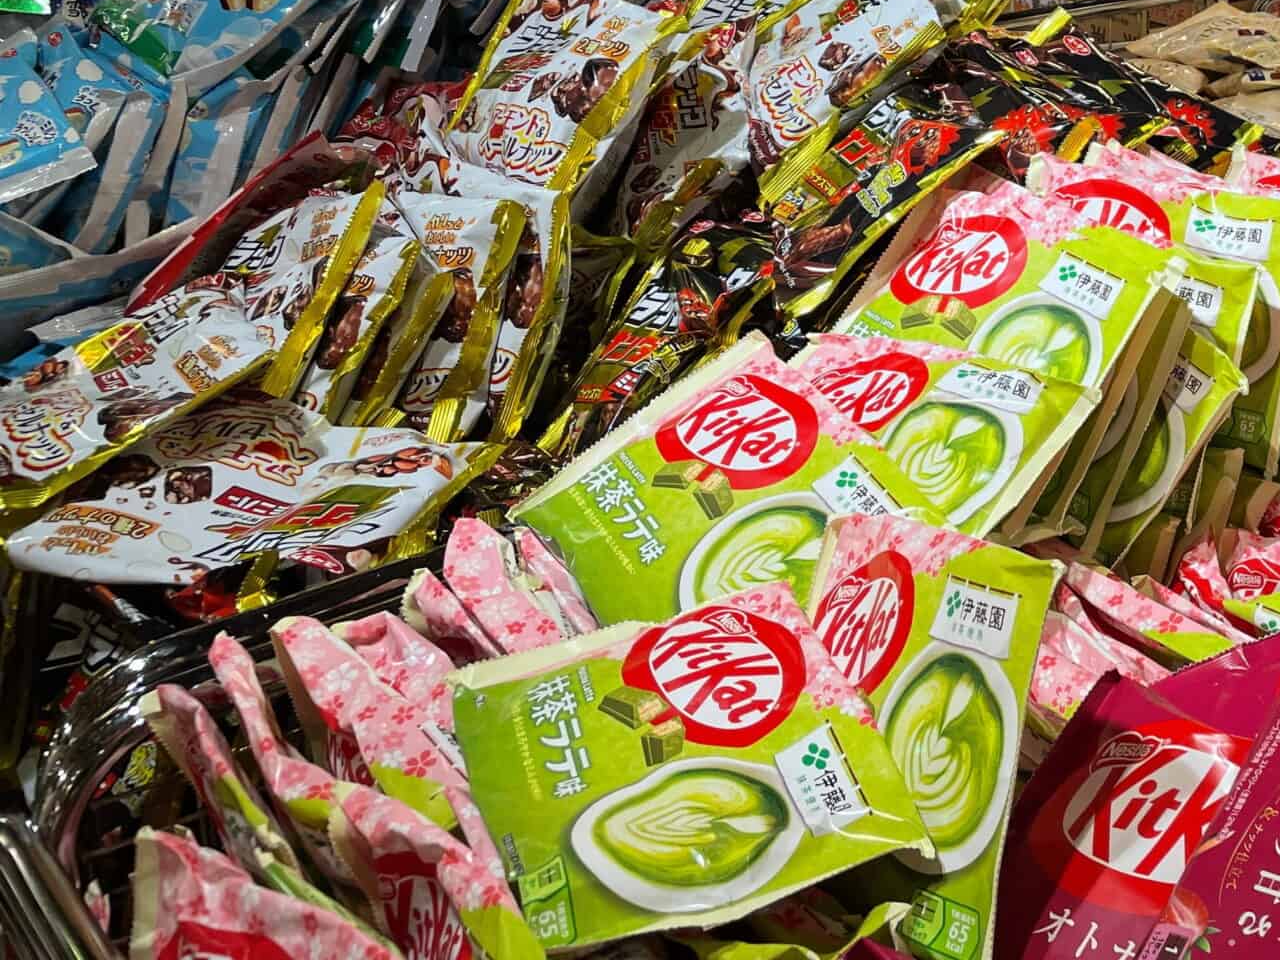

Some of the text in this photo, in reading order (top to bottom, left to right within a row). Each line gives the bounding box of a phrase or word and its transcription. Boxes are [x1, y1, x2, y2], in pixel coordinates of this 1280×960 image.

[905, 231, 1008, 293] KitKat
[1216, 224, 1263, 245] 伊藤園
[1076, 272, 1114, 303] 伊藤園
[1176, 285, 1214, 310] 藤園
[976, 369, 1033, 401] 伊藤園
[678, 392, 794, 467] KitKat
[580, 460, 668, 566] 抹茶ラテ味
[960, 597, 1006, 632] 伊藤園
[651, 625, 784, 723] KitKat
[526, 673, 590, 800] 抹茶ラテ味
[1068, 747, 1230, 878] KitK
